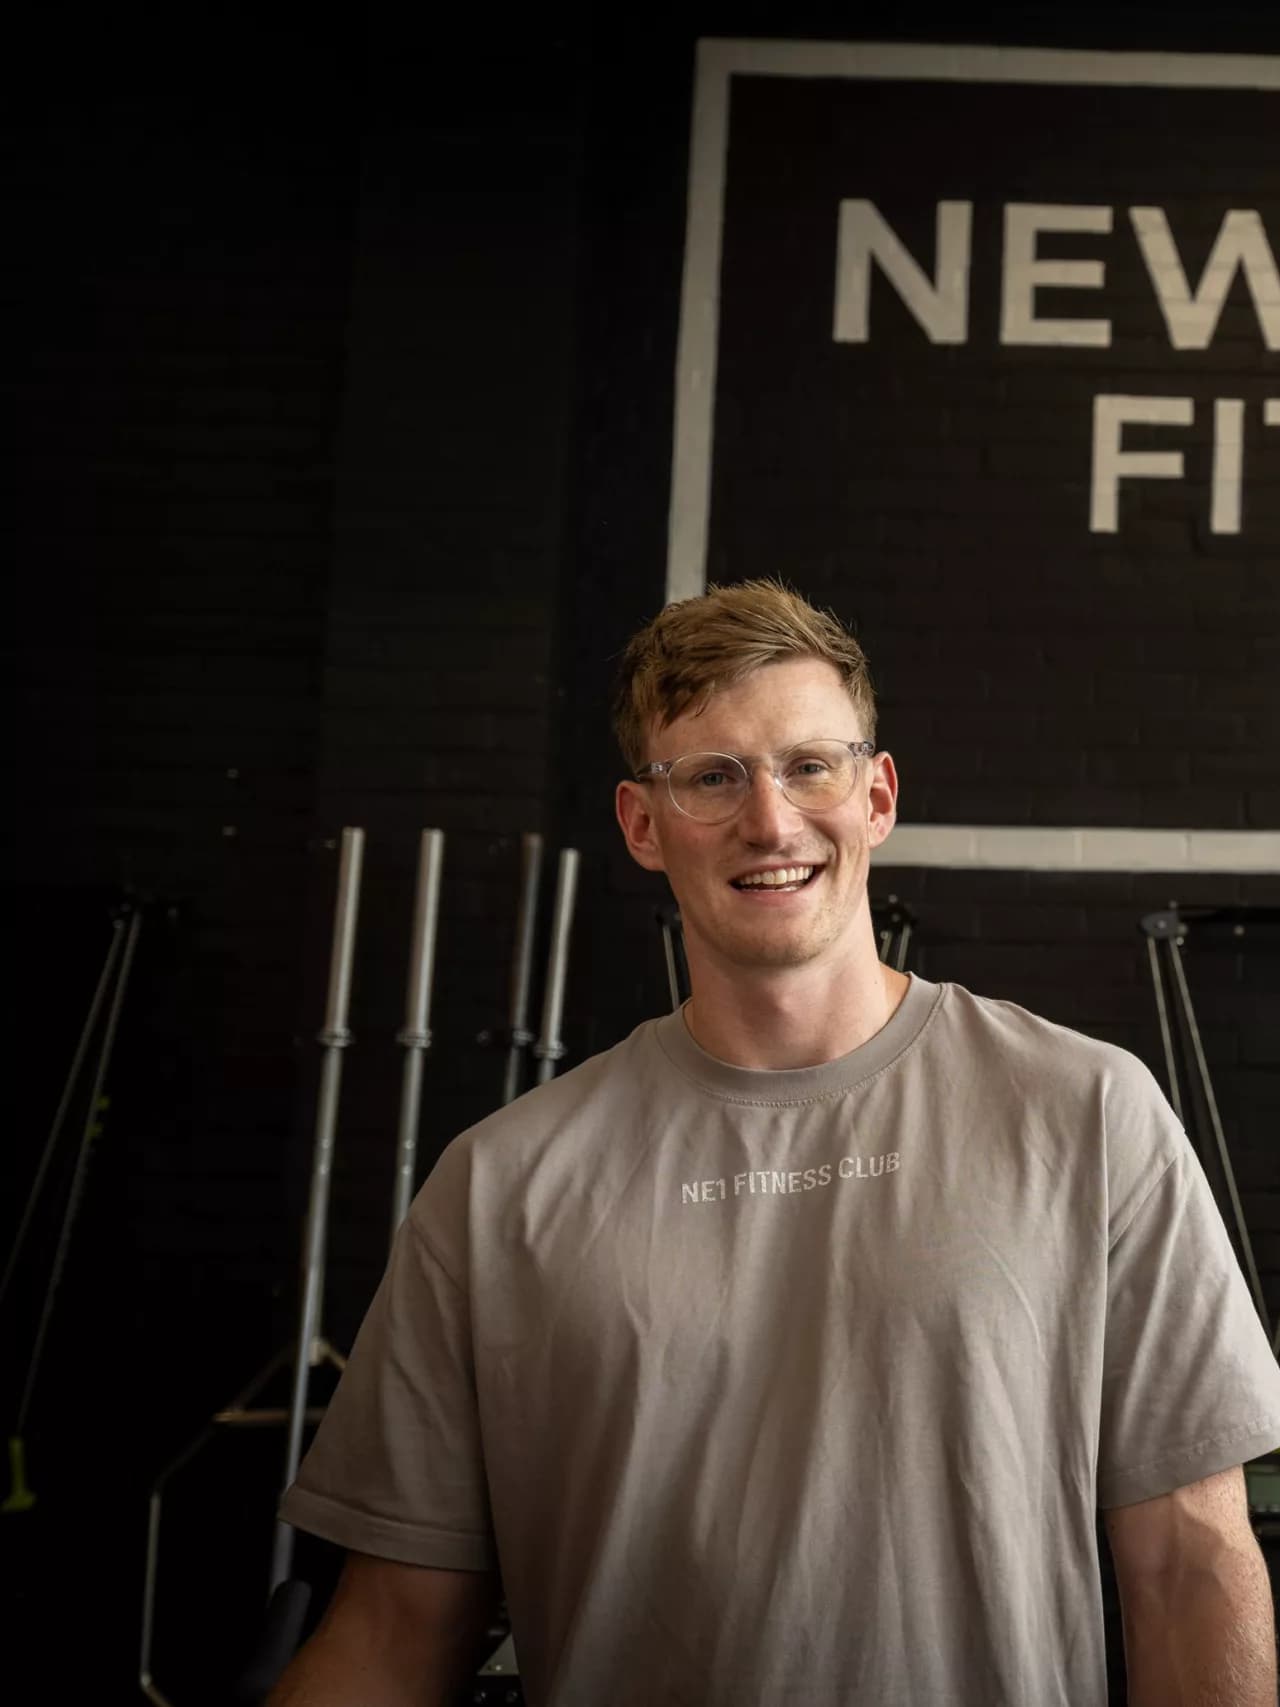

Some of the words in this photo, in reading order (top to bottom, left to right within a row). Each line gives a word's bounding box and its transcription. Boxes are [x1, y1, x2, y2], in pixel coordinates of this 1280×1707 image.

[681, 1178, 726, 1204] NE1
[733, 1164, 832, 1196] FITNESS
[838, 1152, 900, 1179] CLUB
